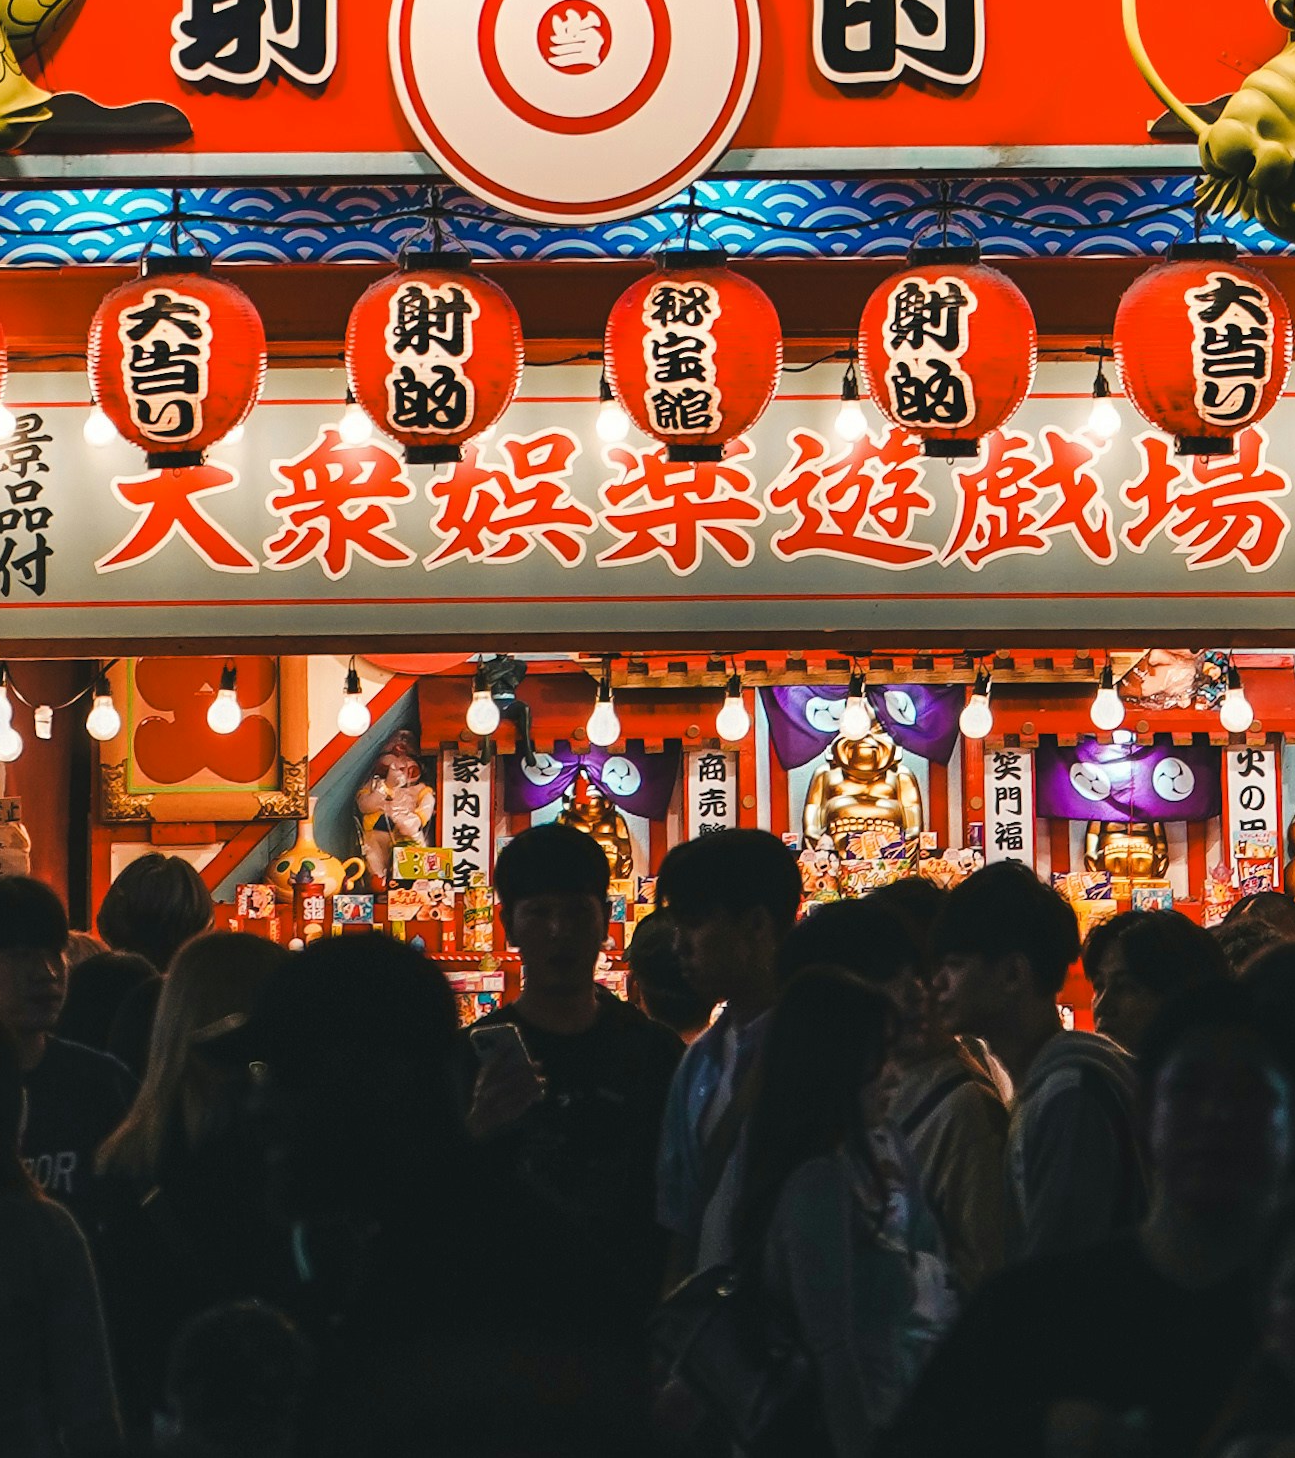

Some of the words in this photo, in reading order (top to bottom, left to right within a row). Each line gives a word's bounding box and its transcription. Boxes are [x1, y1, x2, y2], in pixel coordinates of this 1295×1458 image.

[546, 6, 607, 72] 当
[117, 288, 214, 443] 大当り
[385, 279, 481, 434] 射的
[641, 279, 722, 434] 秘宝館
[880, 276, 979, 431] 射的
[1183, 271, 1275, 426] 大当り
[95, 424, 1292, 580] 大衆娯楽遊戯場
[451, 754, 481, 889] 家内安全
[990, 750, 1023, 864] 笑門福
